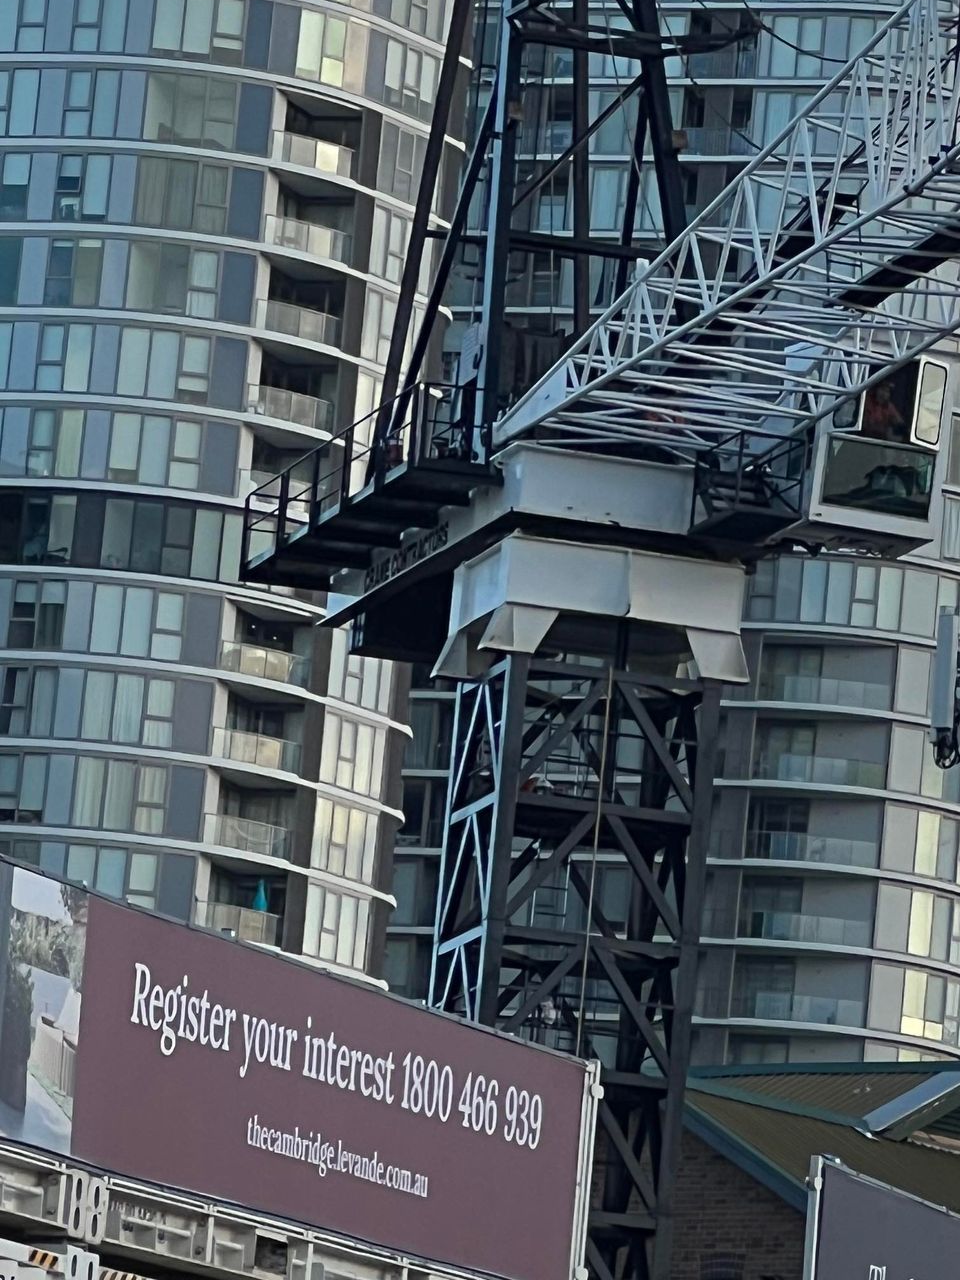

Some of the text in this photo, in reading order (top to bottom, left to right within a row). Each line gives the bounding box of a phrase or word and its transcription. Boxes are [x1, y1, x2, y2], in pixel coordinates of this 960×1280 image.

[131, 963, 543, 1150] Register your interest 1800 466 939
[247, 1115, 429, 1198] thecambridge.levande.com.au
